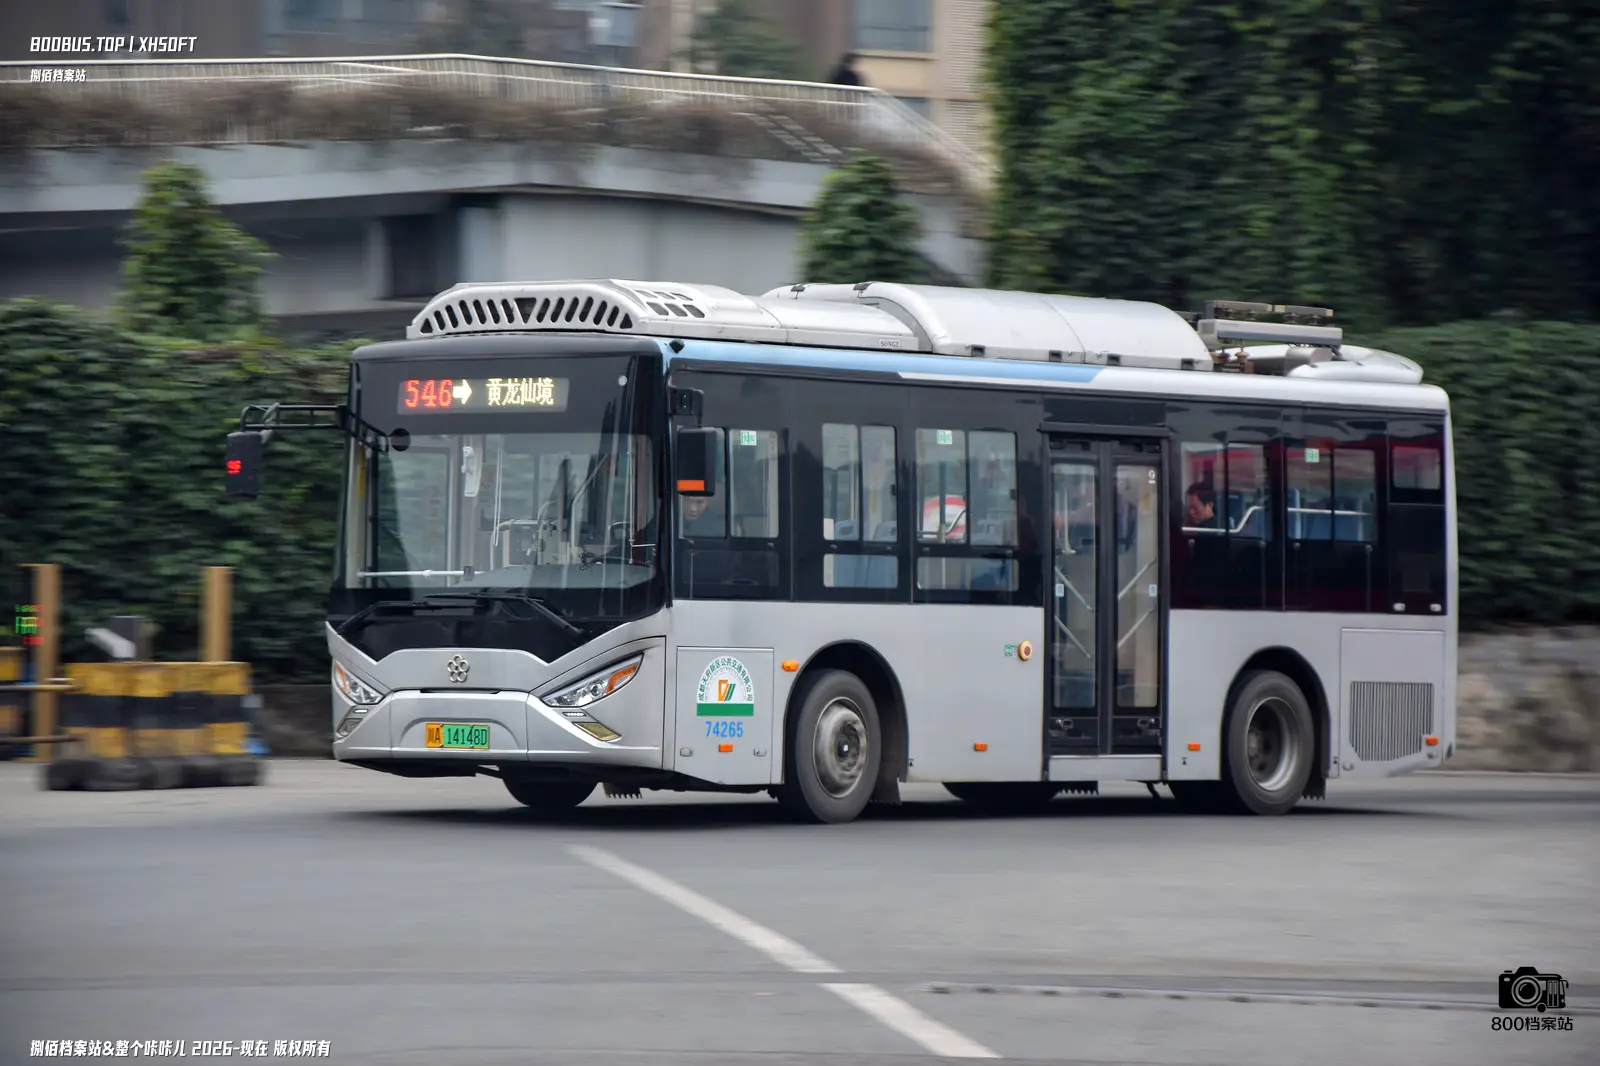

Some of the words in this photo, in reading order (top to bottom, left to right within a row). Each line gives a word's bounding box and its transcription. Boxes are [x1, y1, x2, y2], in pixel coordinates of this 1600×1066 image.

[404, 379, 453, 408] 546
[485, 376, 555, 406] 黄龙仙境
[705, 721, 744, 738] 74265
